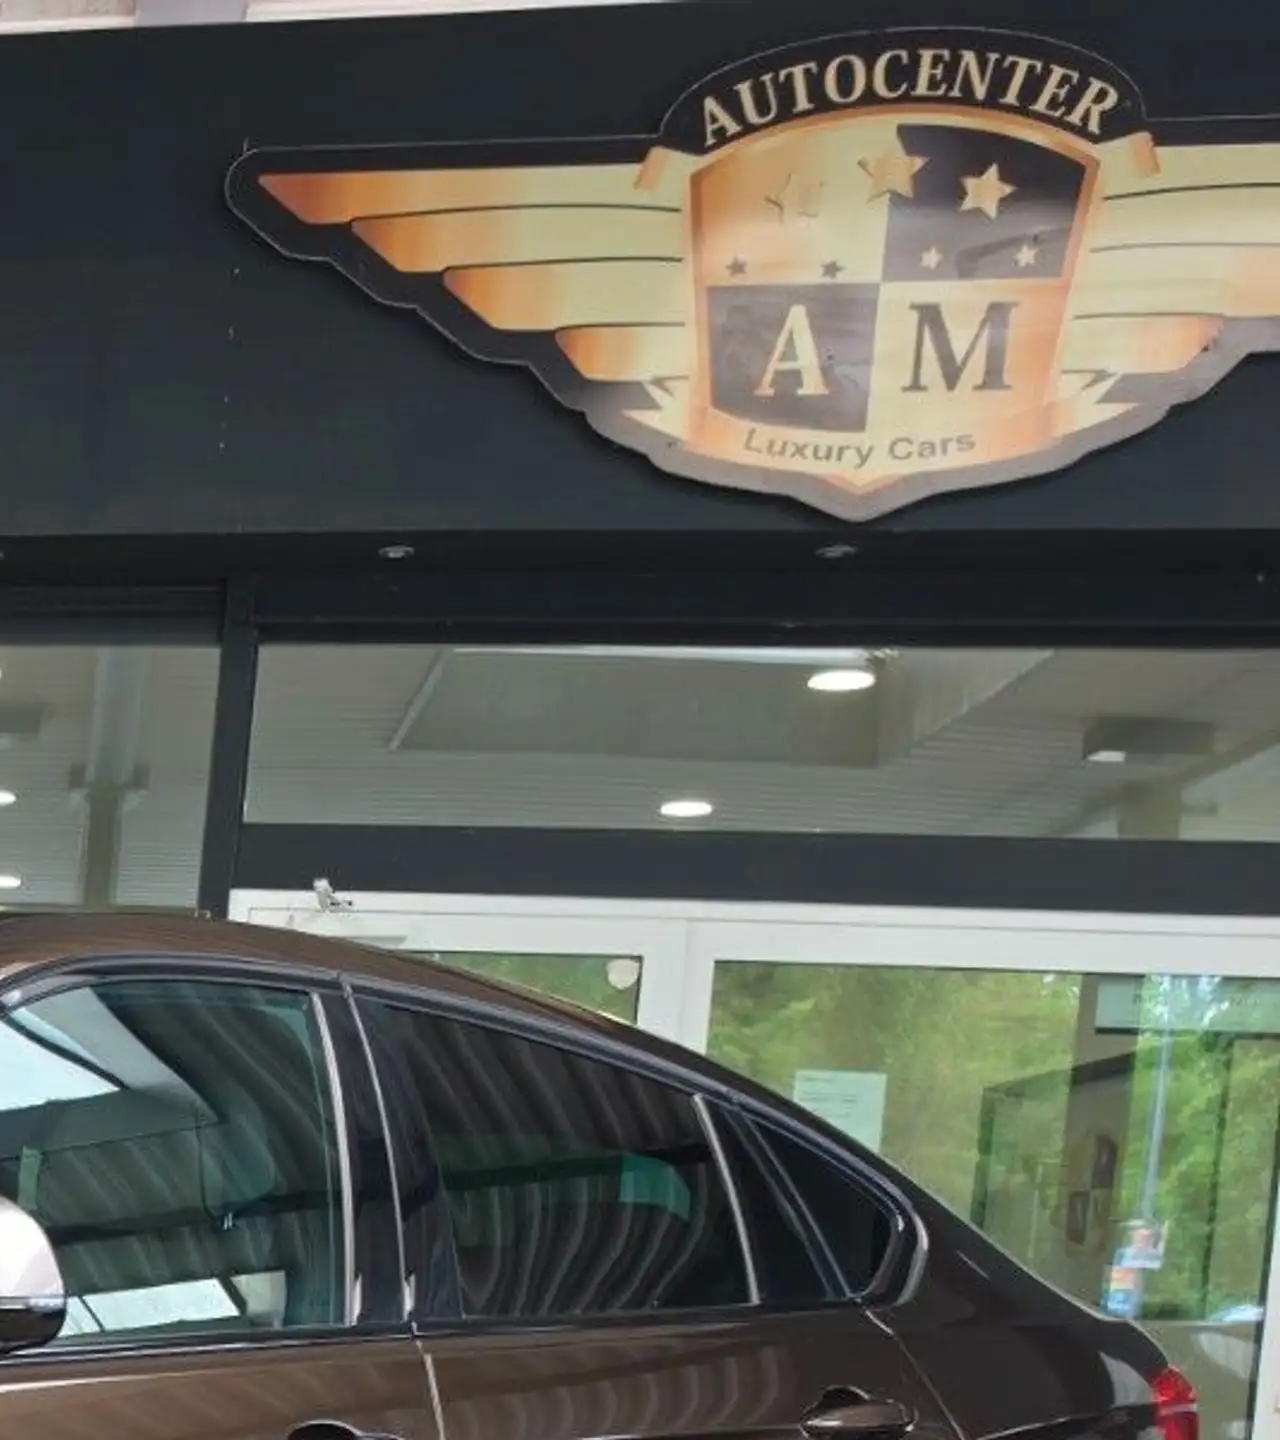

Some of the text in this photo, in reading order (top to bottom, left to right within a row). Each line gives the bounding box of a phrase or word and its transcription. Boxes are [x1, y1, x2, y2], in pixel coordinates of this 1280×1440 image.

[702, 49, 1120, 148] AUTOCENTER
[743, 428, 976, 469] Luxury Cars
